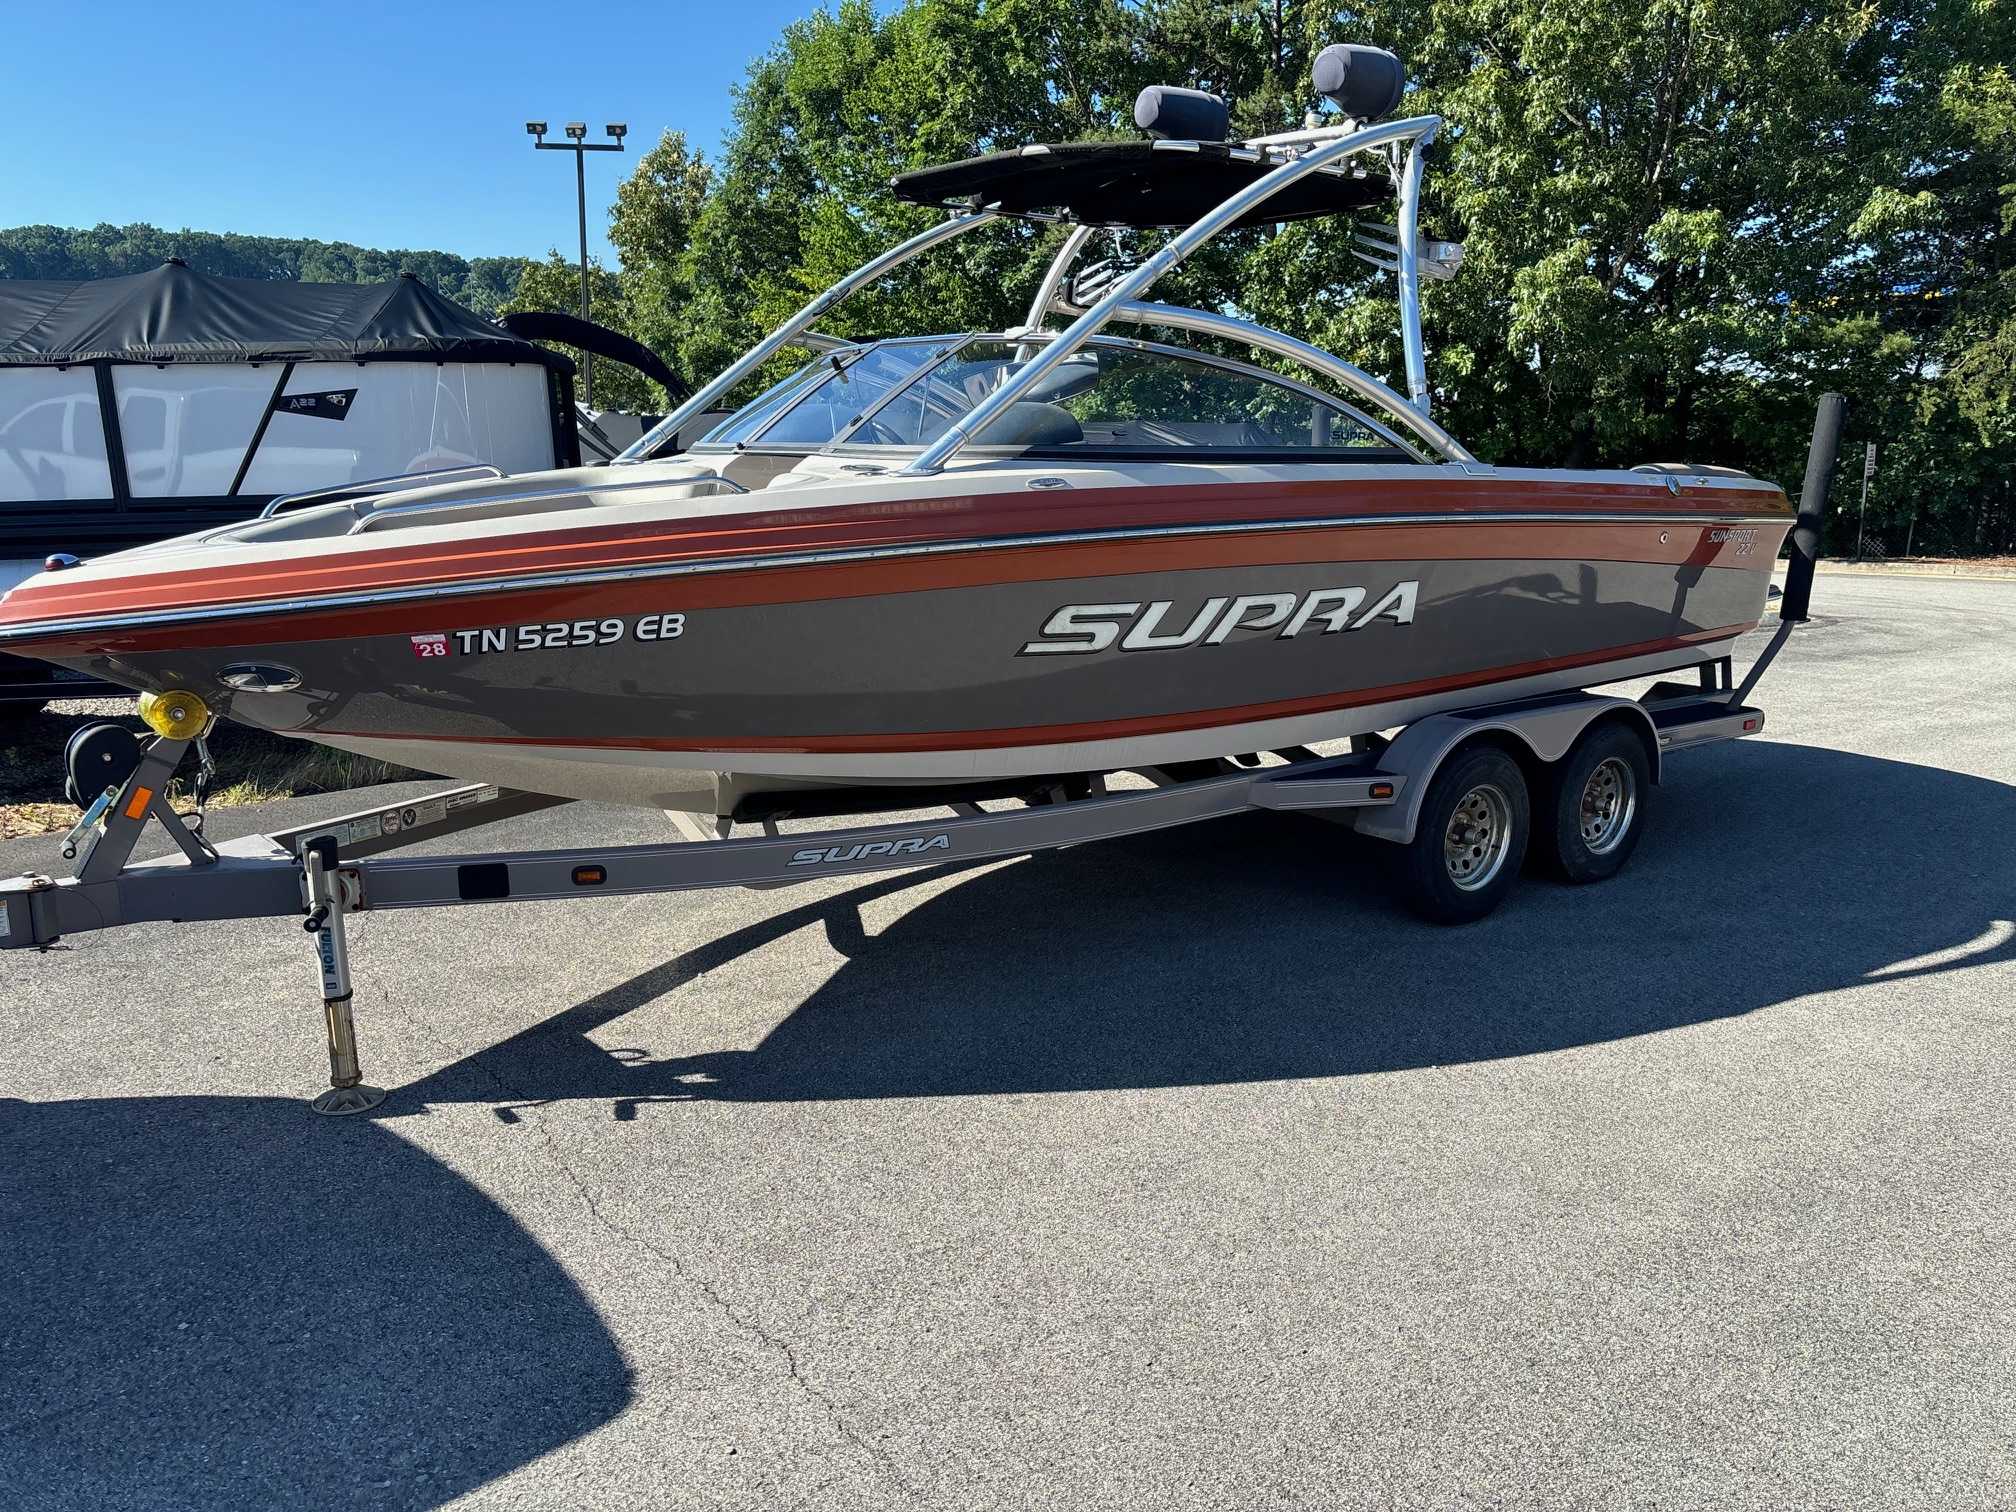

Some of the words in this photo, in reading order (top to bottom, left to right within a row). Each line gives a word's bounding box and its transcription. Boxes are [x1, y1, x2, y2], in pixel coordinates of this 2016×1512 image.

[1332, 430, 1374, 441] SUPRA
[1708, 529, 1758, 543] SUNSPORT
[454, 629, 506, 655] TN
[515, 618, 625, 651] 5259
[633, 613, 687, 642] EB
[1014, 580, 1419, 657] SUPRA
[420, 643, 446, 657] 28
[785, 834, 950, 867] SUPRA
[320, 927, 336, 975] FULTON
